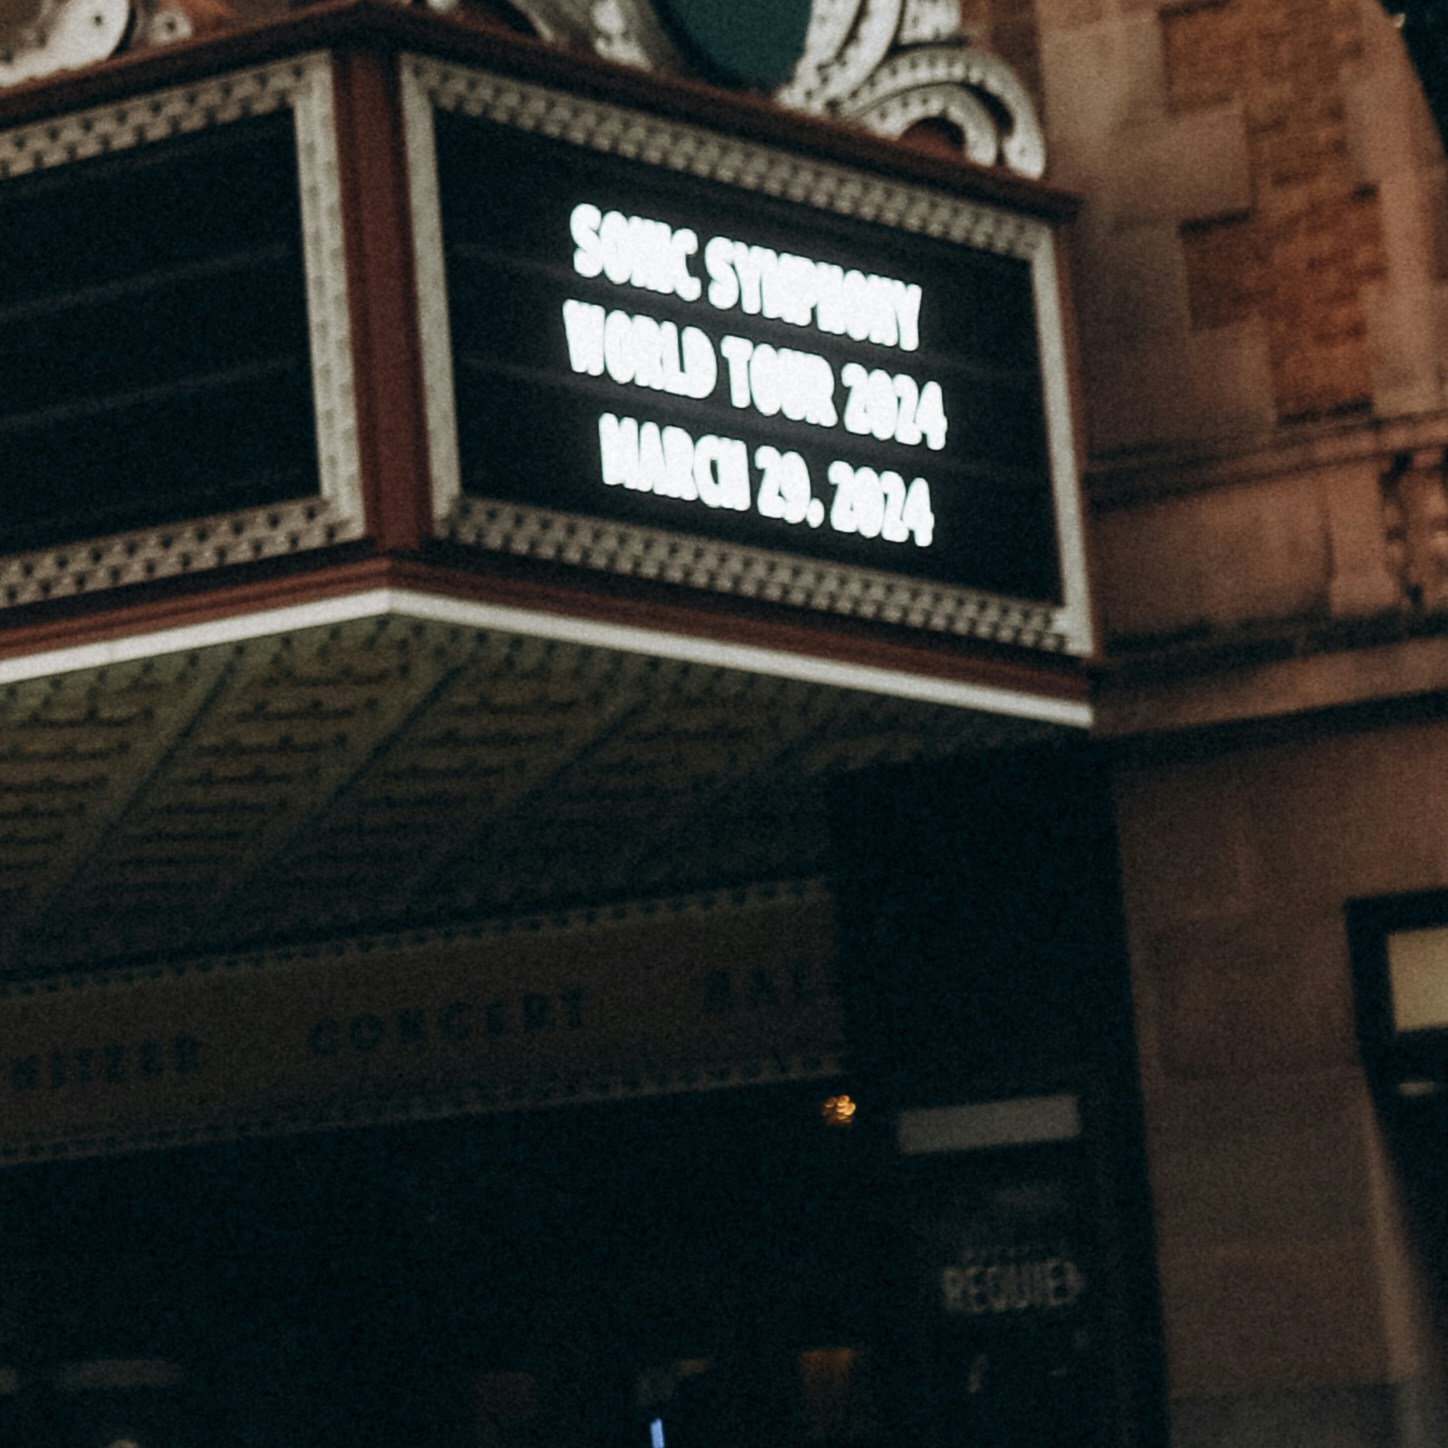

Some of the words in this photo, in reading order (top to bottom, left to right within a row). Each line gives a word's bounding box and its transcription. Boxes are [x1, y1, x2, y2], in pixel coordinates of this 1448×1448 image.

[570, 203, 702, 302] SONIC
[704, 236, 922, 352] SYMPHONY
[562, 299, 718, 399] WORLD
[720, 335, 839, 428] TOUR
[841, 362, 948, 451] 2024
[598, 412, 751, 512] MARCH
[827, 460, 935, 547] 2024
[304, 984, 589, 1058] CONCERT
